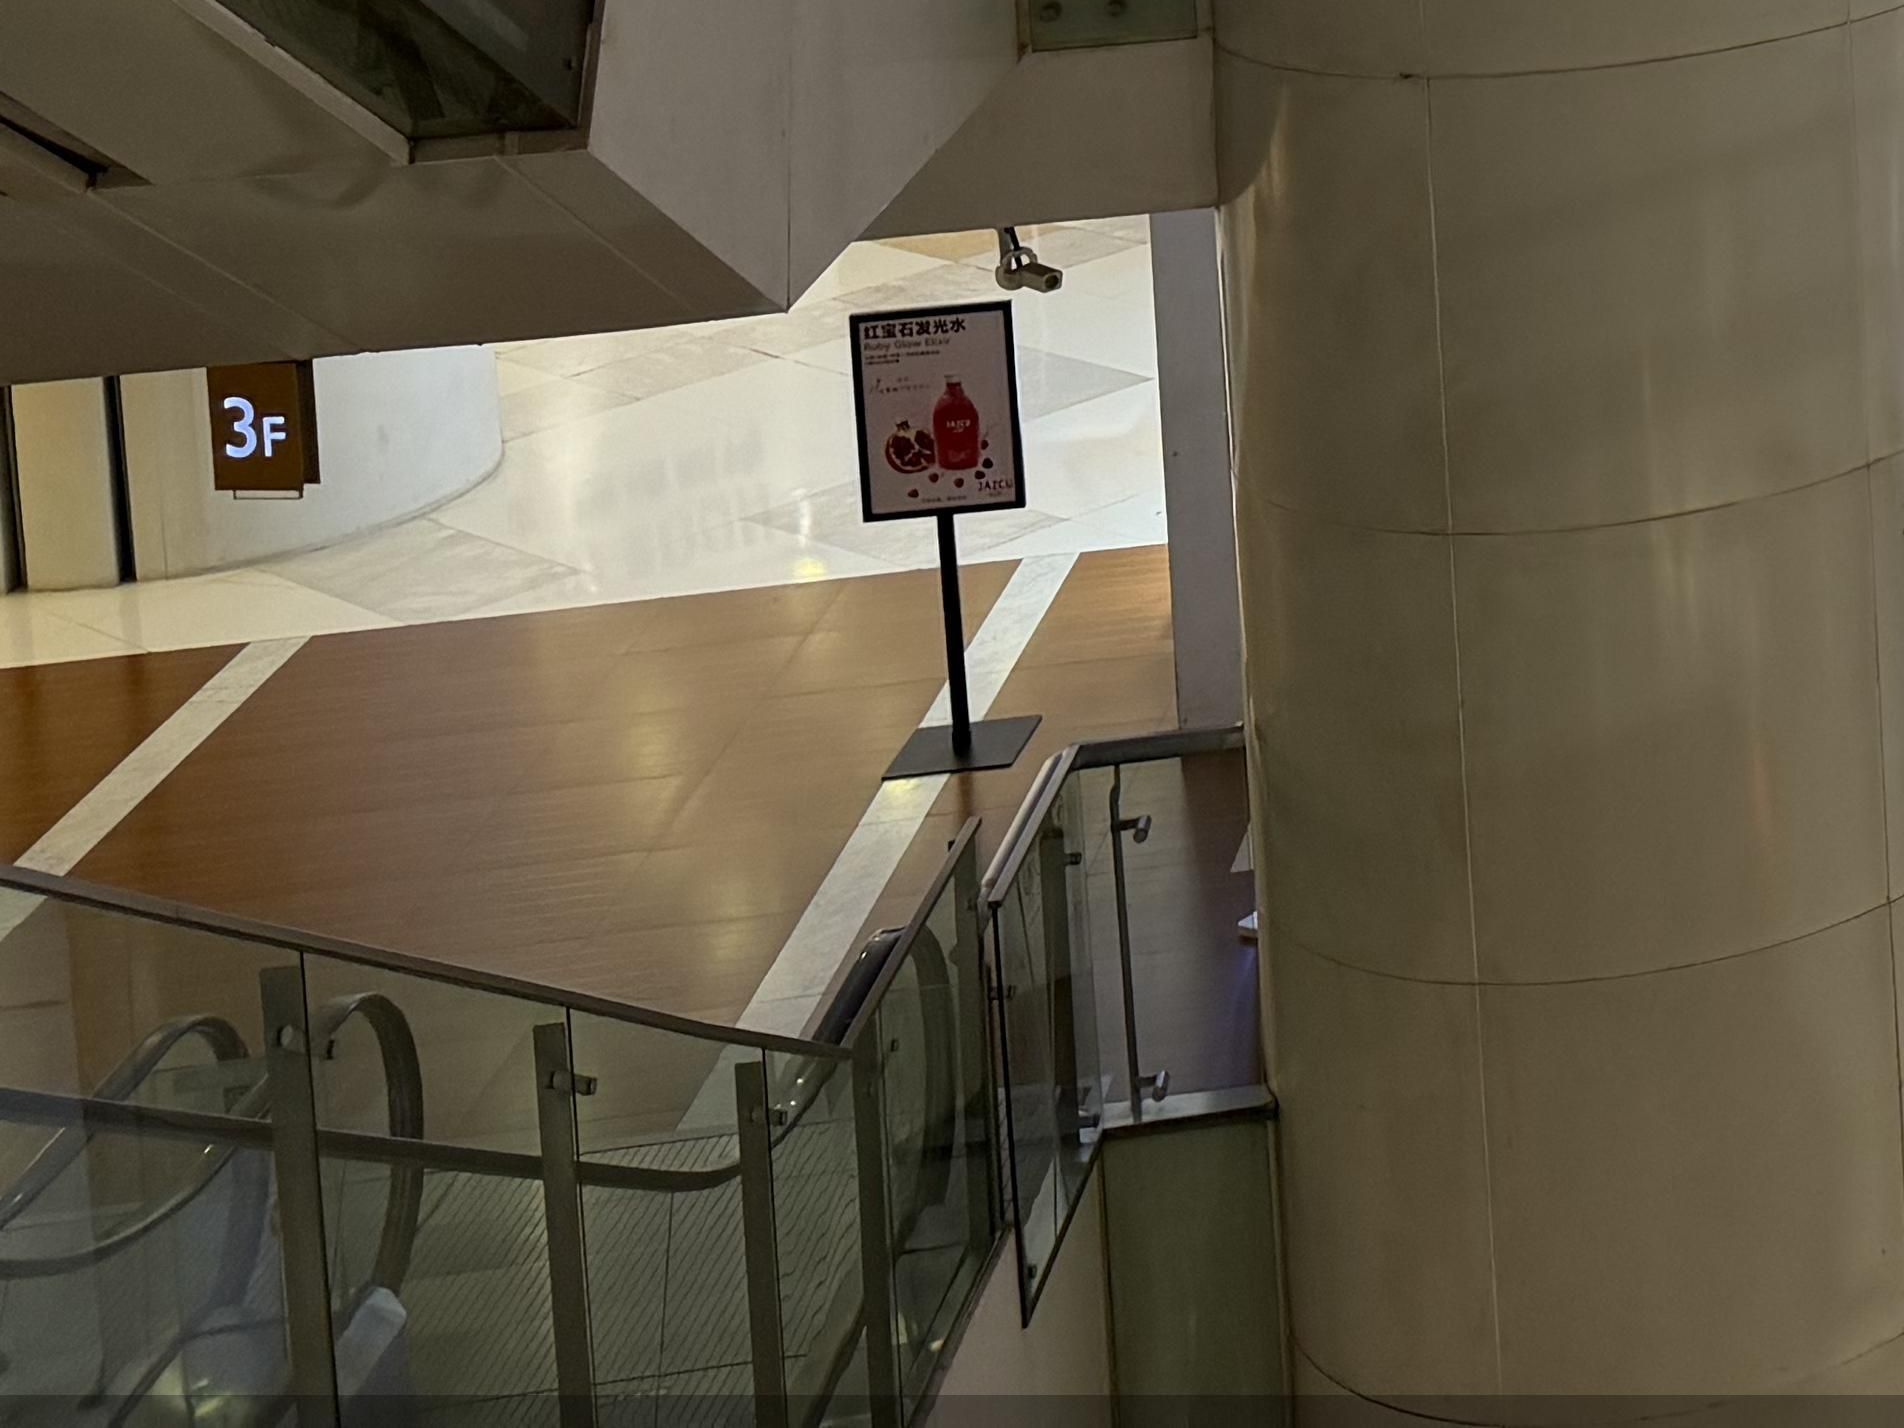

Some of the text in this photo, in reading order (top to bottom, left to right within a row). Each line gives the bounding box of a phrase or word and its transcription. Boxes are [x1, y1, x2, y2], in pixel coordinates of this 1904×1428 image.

[863, 317, 967, 341] 红宝石发光水
[223, 395, 287, 459] 3F
